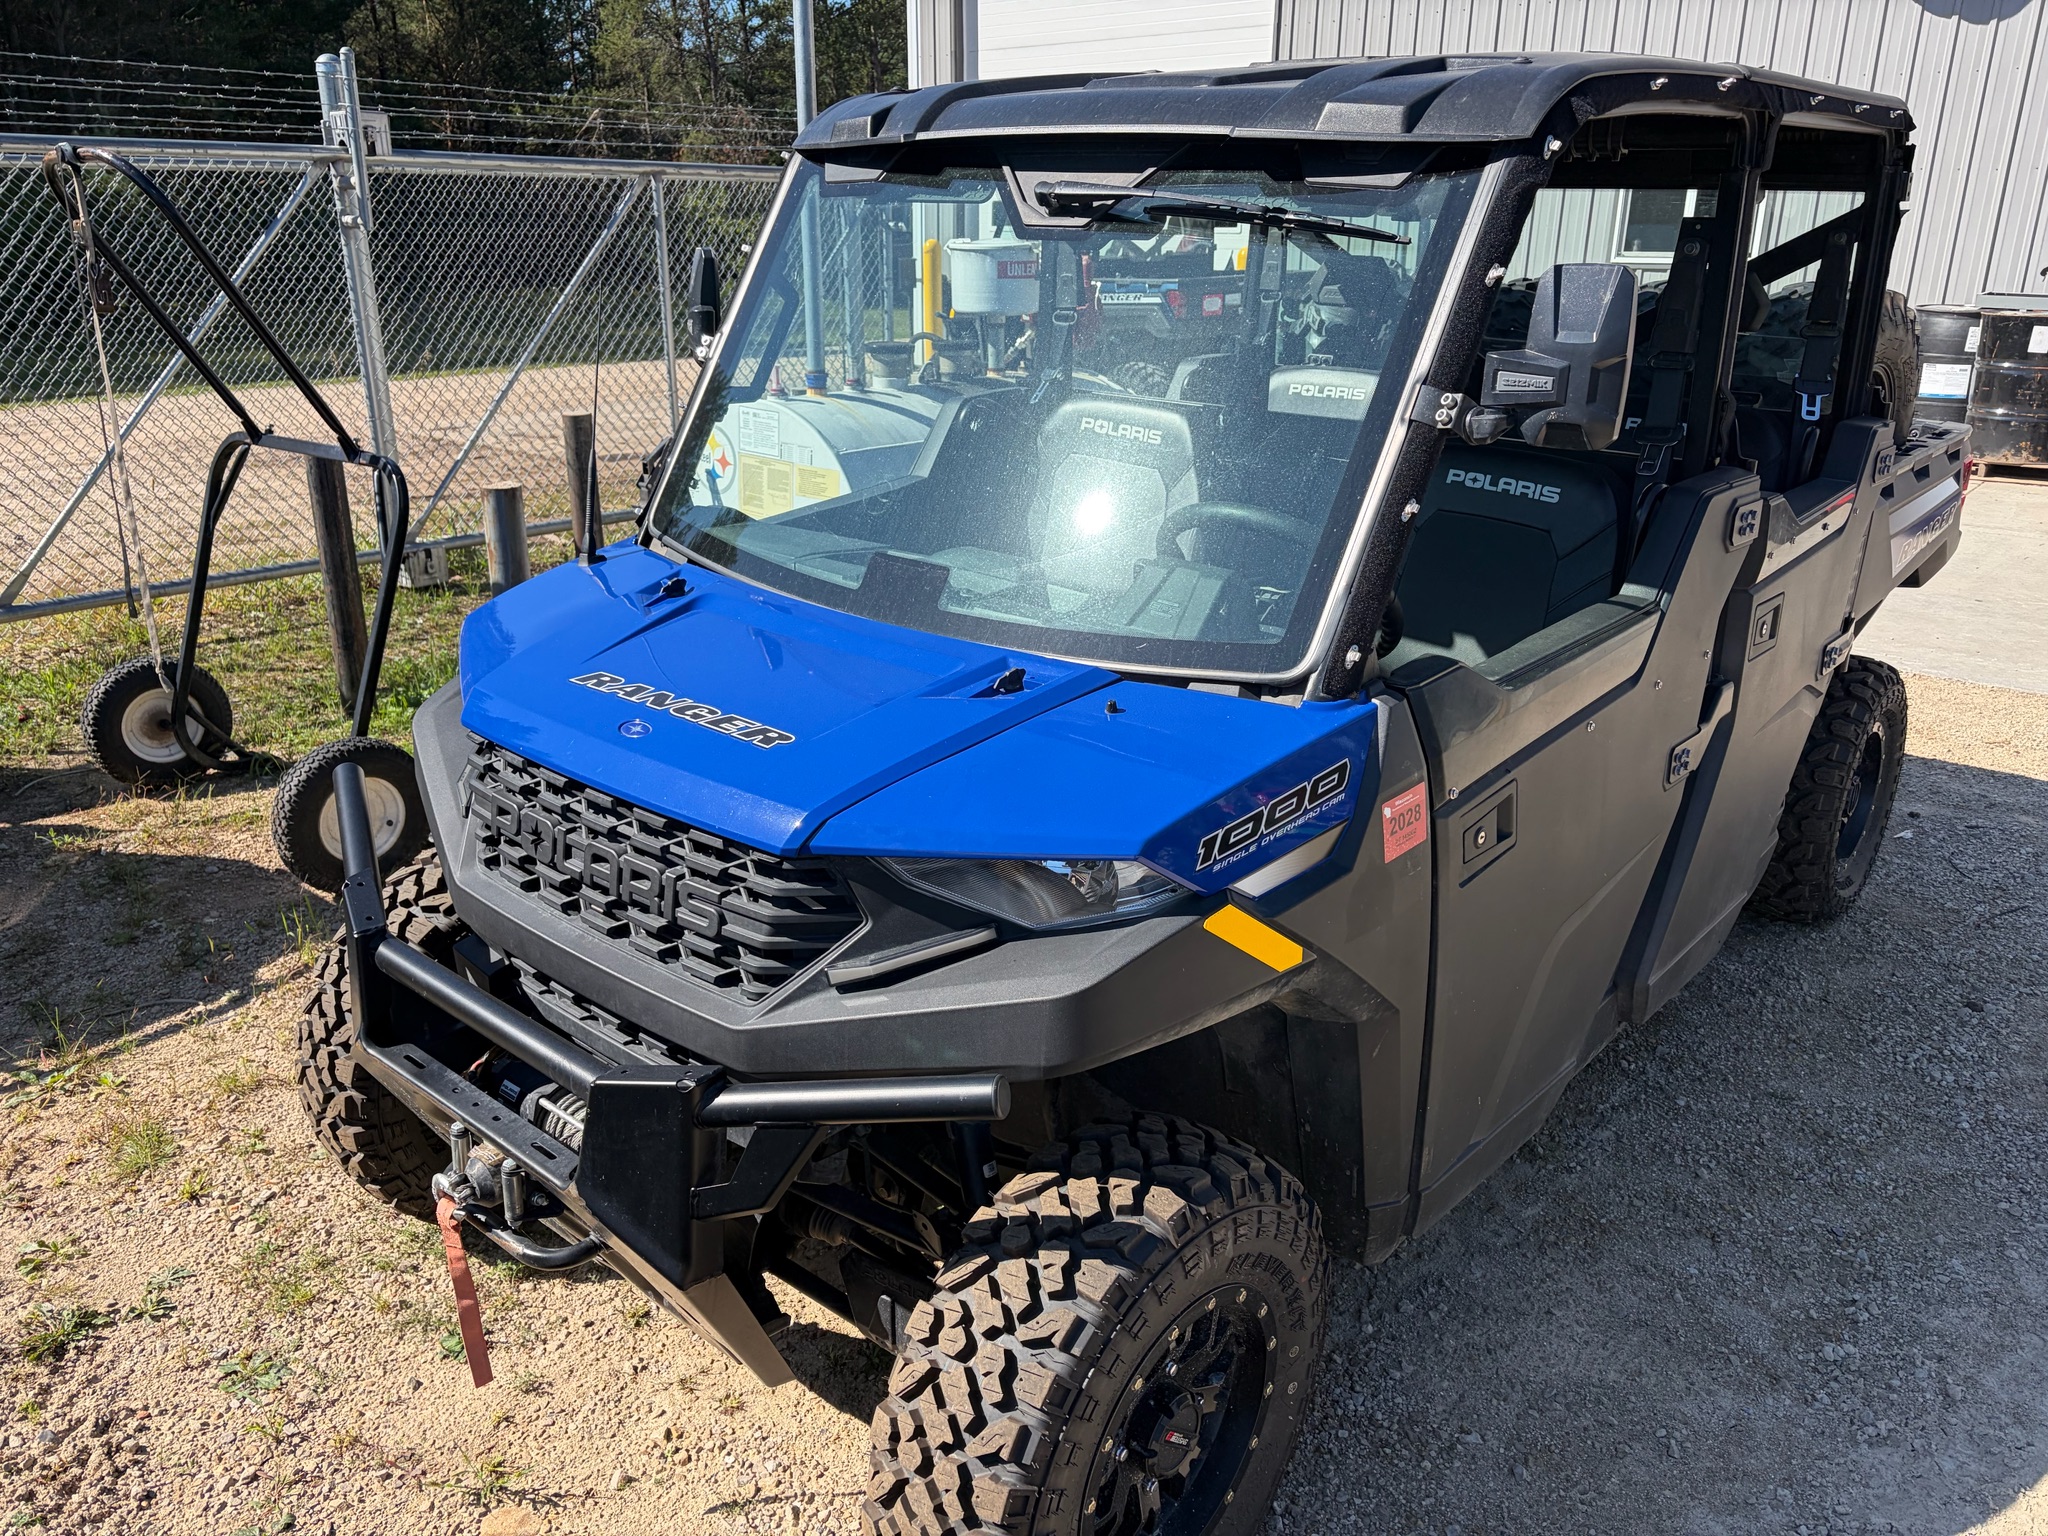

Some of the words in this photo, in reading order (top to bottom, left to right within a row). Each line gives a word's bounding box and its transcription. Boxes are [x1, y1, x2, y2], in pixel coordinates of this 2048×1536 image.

[1289, 384, 1366, 400] POLARIS
[1502, 377, 1548, 389] SEIZMIK
[1081, 417, 1163, 444] POLARIS
[701, 451, 711, 464] eel
[1446, 469, 1561, 503] POLARIS
[1896, 502, 1957, 567] RANGER
[569, 672, 795, 749] RANGER
[1196, 758, 1350, 871] 1000
[1213, 843, 1257, 872] SINGLE
[1261, 808, 1319, 845] OVERHEAD
[1322, 794, 1345, 812] CAM
[1390, 804, 1421, 837] 2028
[491, 791, 723, 937] POLARIS
[1226, 1252, 1296, 1294] KLEVER
